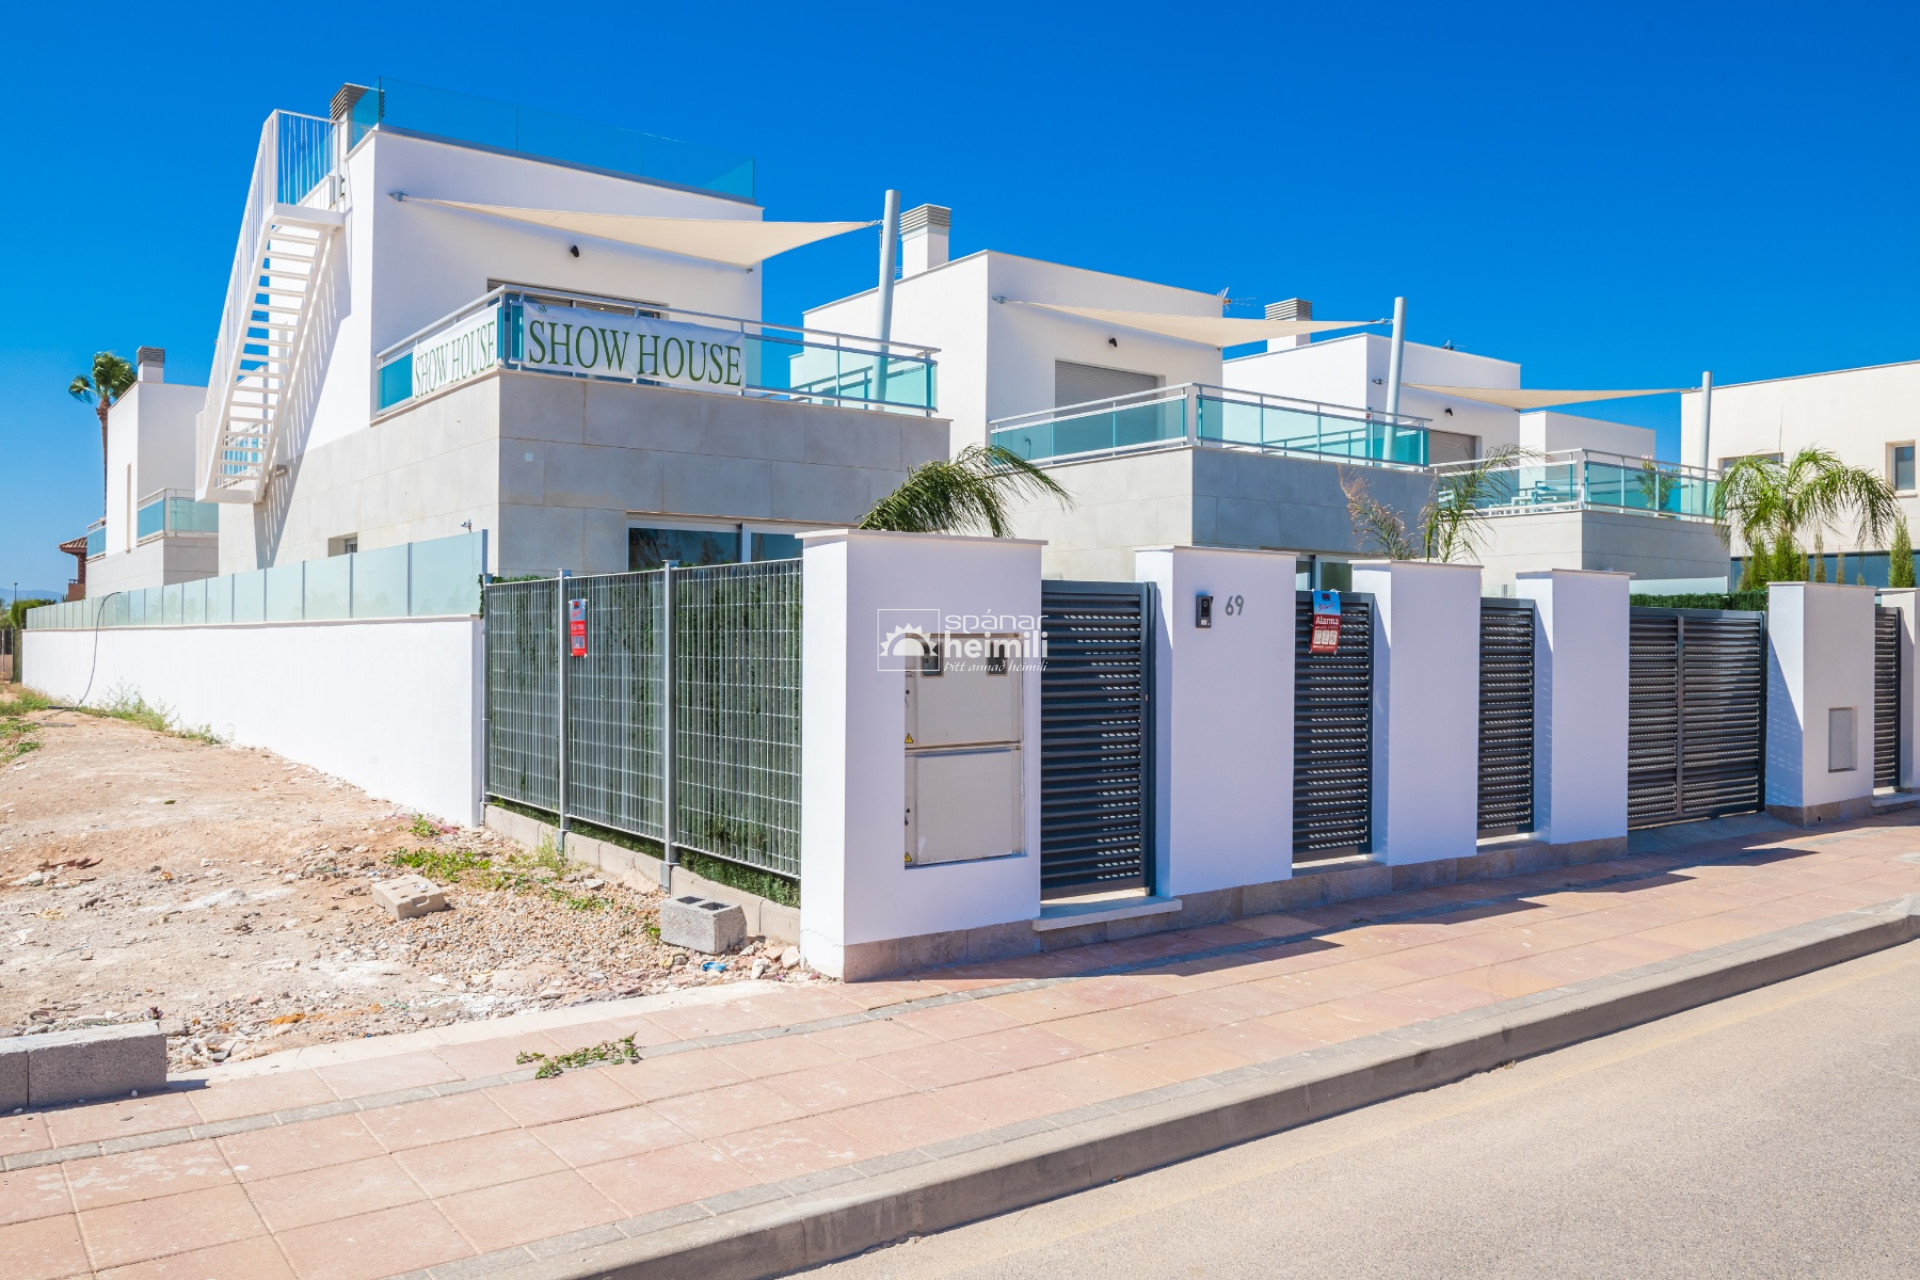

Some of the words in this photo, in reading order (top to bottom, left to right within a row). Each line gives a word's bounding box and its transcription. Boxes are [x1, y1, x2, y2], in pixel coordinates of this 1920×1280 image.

[415, 343, 449, 399] SHOW
[450, 320, 496, 383] HOUSE
[529, 320, 630, 372] SHOW
[637, 333, 743, 387] HOUSE
[1225, 594, 1244, 616] 69
[1315, 615, 1339, 625] Alarma
